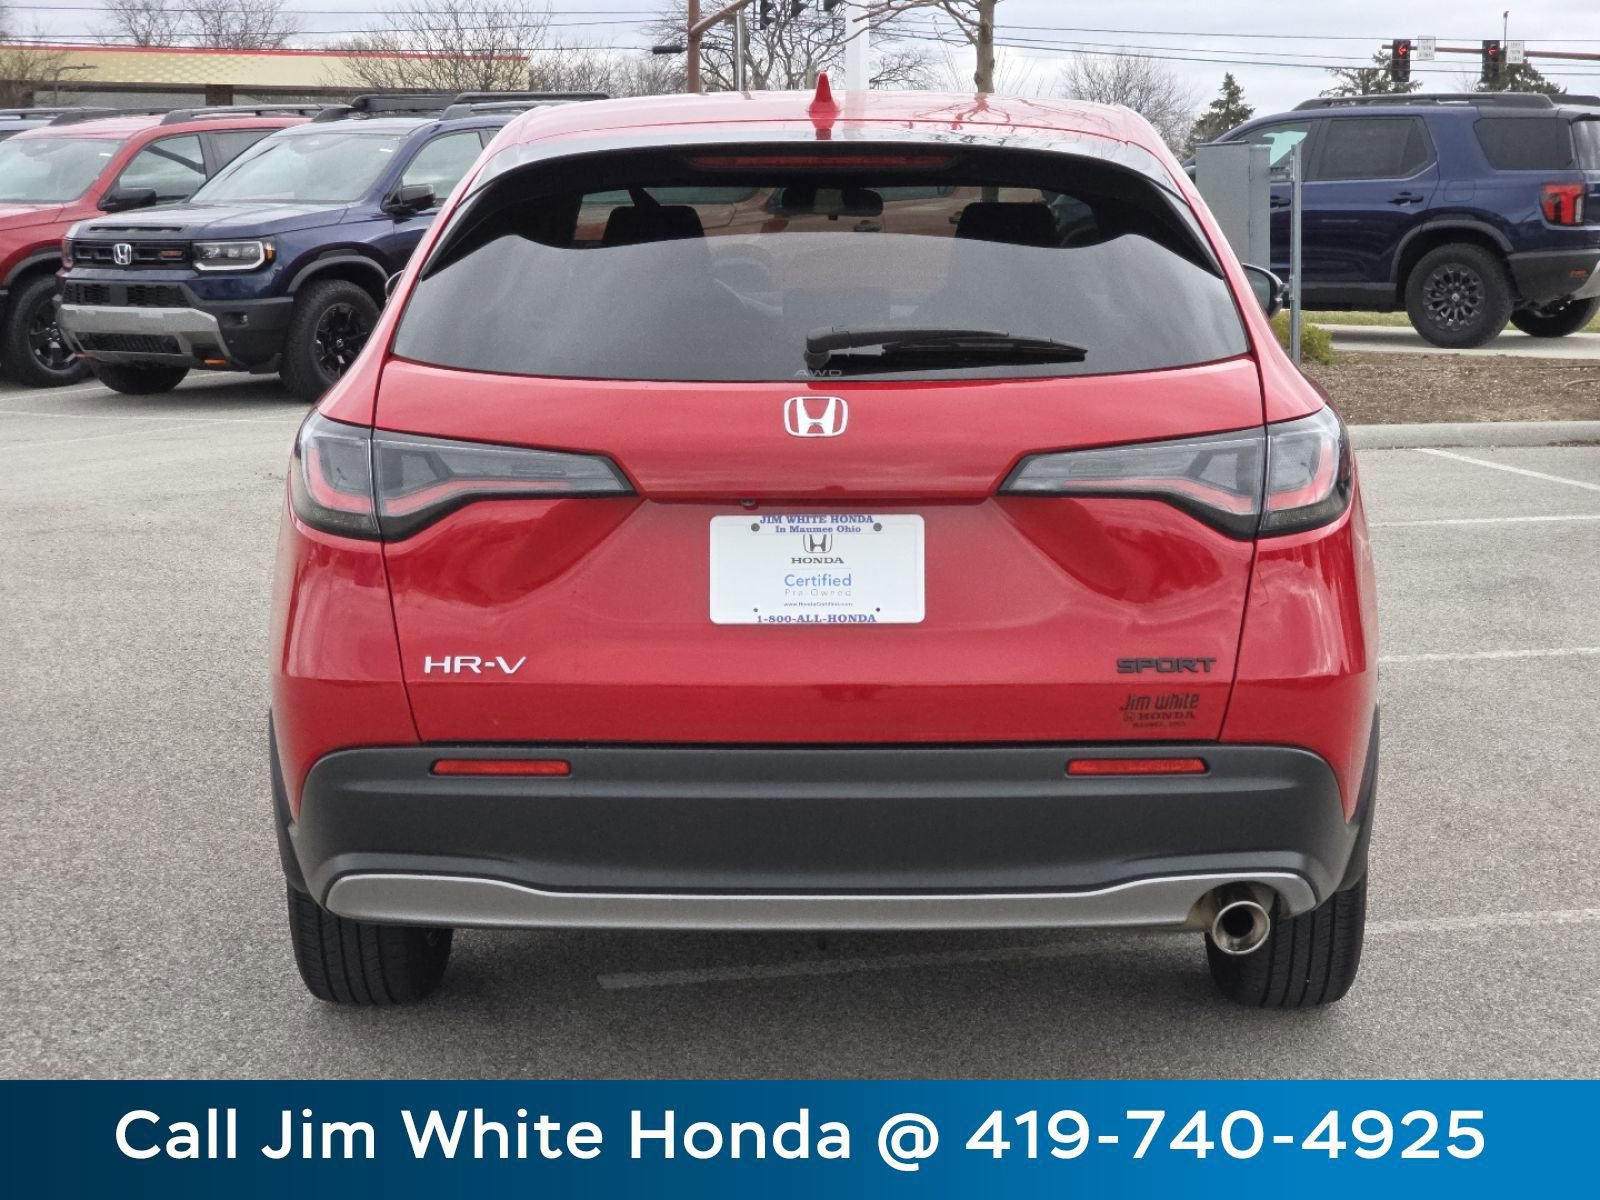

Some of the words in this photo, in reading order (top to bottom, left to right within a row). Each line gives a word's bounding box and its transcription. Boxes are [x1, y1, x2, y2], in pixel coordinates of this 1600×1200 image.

[794, 369, 842, 377] AWD
[760, 515, 782, 524] JIM
[786, 515, 827, 524] WHITE
[830, 515, 874, 524] HONDA
[836, 525, 862, 533] Ohio
[784, 573, 852, 587] Certified
[757, 614, 877, 623] 1-800-ALL-HONDA
[424, 656, 526, 674] HR-V
[1116, 658, 1216, 673] SPORT
[1138, 711, 1195, 720] HONDA
